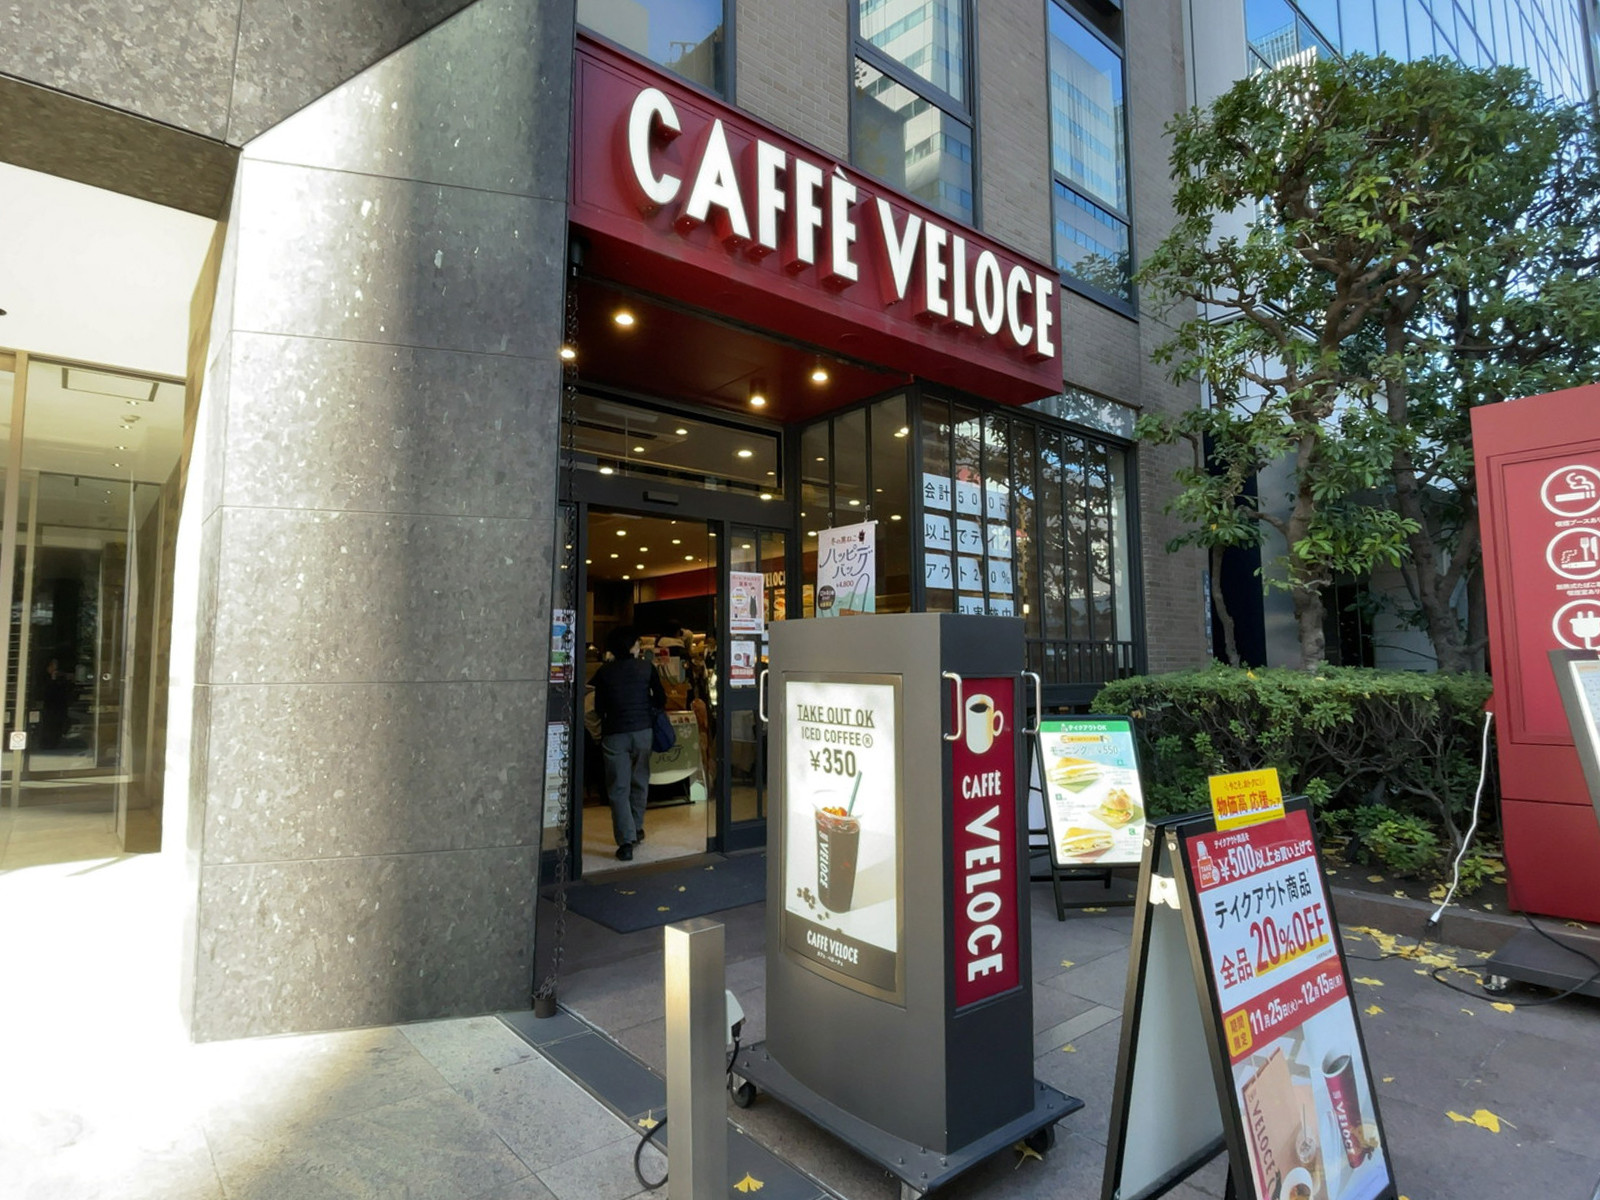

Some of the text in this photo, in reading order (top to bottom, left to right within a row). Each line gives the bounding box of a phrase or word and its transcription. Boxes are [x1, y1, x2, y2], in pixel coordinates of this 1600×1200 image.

[628, 87, 1054, 359] CAFFÈ VELOCE
[797, 704, 875, 728] TAKE OUT OK
[801, 726, 821, 741] ICED
[809, 747, 856, 778] ¥350
[965, 805, 1003, 983] VELOCE
[1215, 871, 1311, 929] テイクアウト商品
[829, 938, 858, 965] VELOCE
[1253, 1099, 1275, 1175] VELOCE
